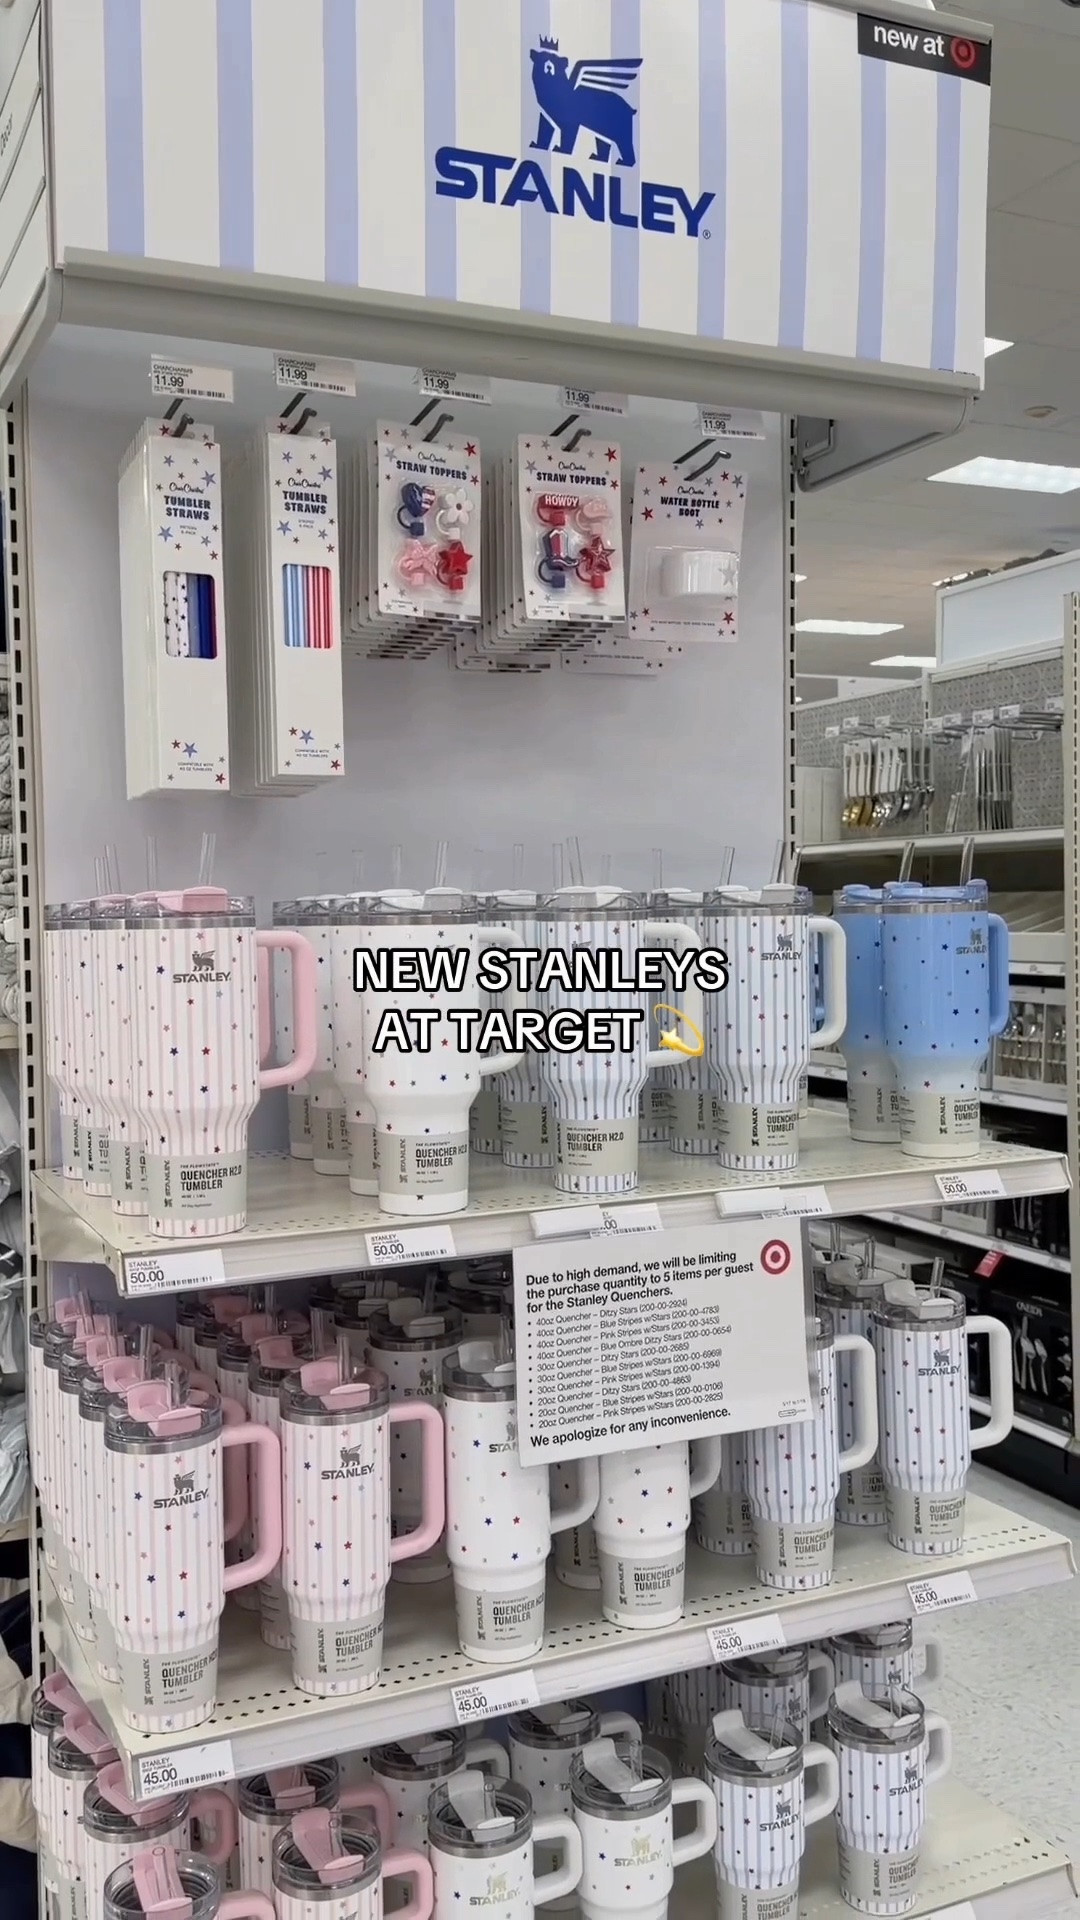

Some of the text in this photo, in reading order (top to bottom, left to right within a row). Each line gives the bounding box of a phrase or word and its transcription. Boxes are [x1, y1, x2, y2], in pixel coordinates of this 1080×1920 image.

[873, 24, 945, 58] new at
[434, 146, 716, 238] STANLEY
[279, 367, 307, 380] 11.99
[154, 375, 184, 388] 11.99
[423, 376, 449, 390] 11.99
[565, 390, 590, 402] 11.99
[704, 419, 726, 430] 11.99
[396, 460, 467, 480] STRAW TOPPERS
[536, 471, 607, 486] STRAW TOPPERS
[163, 495, 211, 510] TUMBLER
[282, 490, 328, 504] TUMBLER
[544, 493, 579, 506] HOWDY
[660, 496, 720, 509] WATER BOTTLE
[165, 506, 210, 521] STRAWS
[284, 502, 327, 515] STRAWS
[678, 507, 700, 517] BOOT
[761, 951, 801, 961] STANLEY
[172, 970, 232, 984] STANLEY
[767, 1122, 795, 1133] TUMBLER
[566, 1131, 624, 1142] QUENCHER H2.0
[415, 1146, 458, 1158] QUENCHER
[567, 1142, 603, 1152] TUMBLER
[415, 1157, 453, 1168] TUMBLER
[180, 1167, 228, 1181] QUENCHER
[180, 1179, 223, 1192] TUMBLER
[943, 1183, 968, 1194] 50.00
[371, 1234, 397, 1242] STANLEY
[373, 1243, 404, 1256] 50.00
[129, 1260, 158, 1268] STANLEY
[526, 1251, 737, 1286] Due to high demand, we will be limiting
[130, 1270, 165, 1284] 50.00
[526, 1262, 754, 1300] the purchase quantity to 5 items per guest
[527, 1286, 673, 1314] for the Stanley Quenchers.
[556, 1312, 592, 1324] Quencher
[600, 1309, 618, 1318] Ditzy
[619, 1306, 638, 1315] Stars
[556, 1324, 592, 1335] Quencher
[600, 1321, 616, 1329] Blue
[618, 1316, 642, 1326] Stripes
[556, 1335, 592, 1346] Quencher
[600, 1331, 616, 1340] Pink
[618, 1327, 642, 1337] Stripes
[556, 1346, 592, 1357] Quencher
[601, 1342, 617, 1351] Blue
[618, 1339, 643, 1348] Ombre
[644, 1336, 662, 1345] Ditzy
[664, 1333, 682, 1342] Stars
[557, 1358, 592, 1369] Quencher
[601, 1354, 619, 1362] Ditzy
[620, 1351, 639, 1359] Stars
[557, 1369, 593, 1380] Quencher
[601, 1365, 617, 1374] Blue
[619, 1361, 644, 1371] Stripes
[917, 1364, 961, 1377] STANLEY
[557, 1380, 593, 1392] Quencher
[602, 1376, 617, 1384] Pink
[618, 1372, 643, 1382] Stripes
[558, 1391, 593, 1403] Quencher
[602, 1387, 620, 1396] Ditzy
[621, 1384, 640, 1393] Stars
[558, 1402, 594, 1414] Quencher
[603, 1399, 619, 1407] Blue
[620, 1394, 645, 1404] Stripes
[559, 1414, 594, 1425] Quencher
[603, 1409, 619, 1418] Pink
[620, 1405, 646, 1415] Stripes
[530, 1408, 731, 1448] We apologize for any inconvenience.
[320, 1462, 375, 1480] STANLEY
[153, 1487, 209, 1509] STANLEY
[794, 1541, 826, 1554] TUMBLER
[634, 1567, 675, 1582] QUENCHER
[634, 1578, 671, 1592] TUMBLER
[914, 1590, 938, 1604] 45.00
[492, 1599, 535, 1616] QUENCHER
[493, 1611, 531, 1626] TUMBLER
[336, 1626, 376, 1647] QUENCHER
[716, 1636, 742, 1650] 45.00
[336, 1640, 373, 1656] TUMBLER
[162, 1657, 208, 1678] QUENCHER
[162, 1670, 204, 1688] TUMBLER
[454, 1686, 480, 1697] STANLEY
[458, 1696, 488, 1712] 45.00
[142, 1757, 170, 1768] STANLEY
[144, 1768, 178, 1786] 45.00
[760, 1814, 799, 1832] STANLEY
[614, 1851, 664, 1868] STANLEY
[468, 1888, 520, 1906] STANLEY
